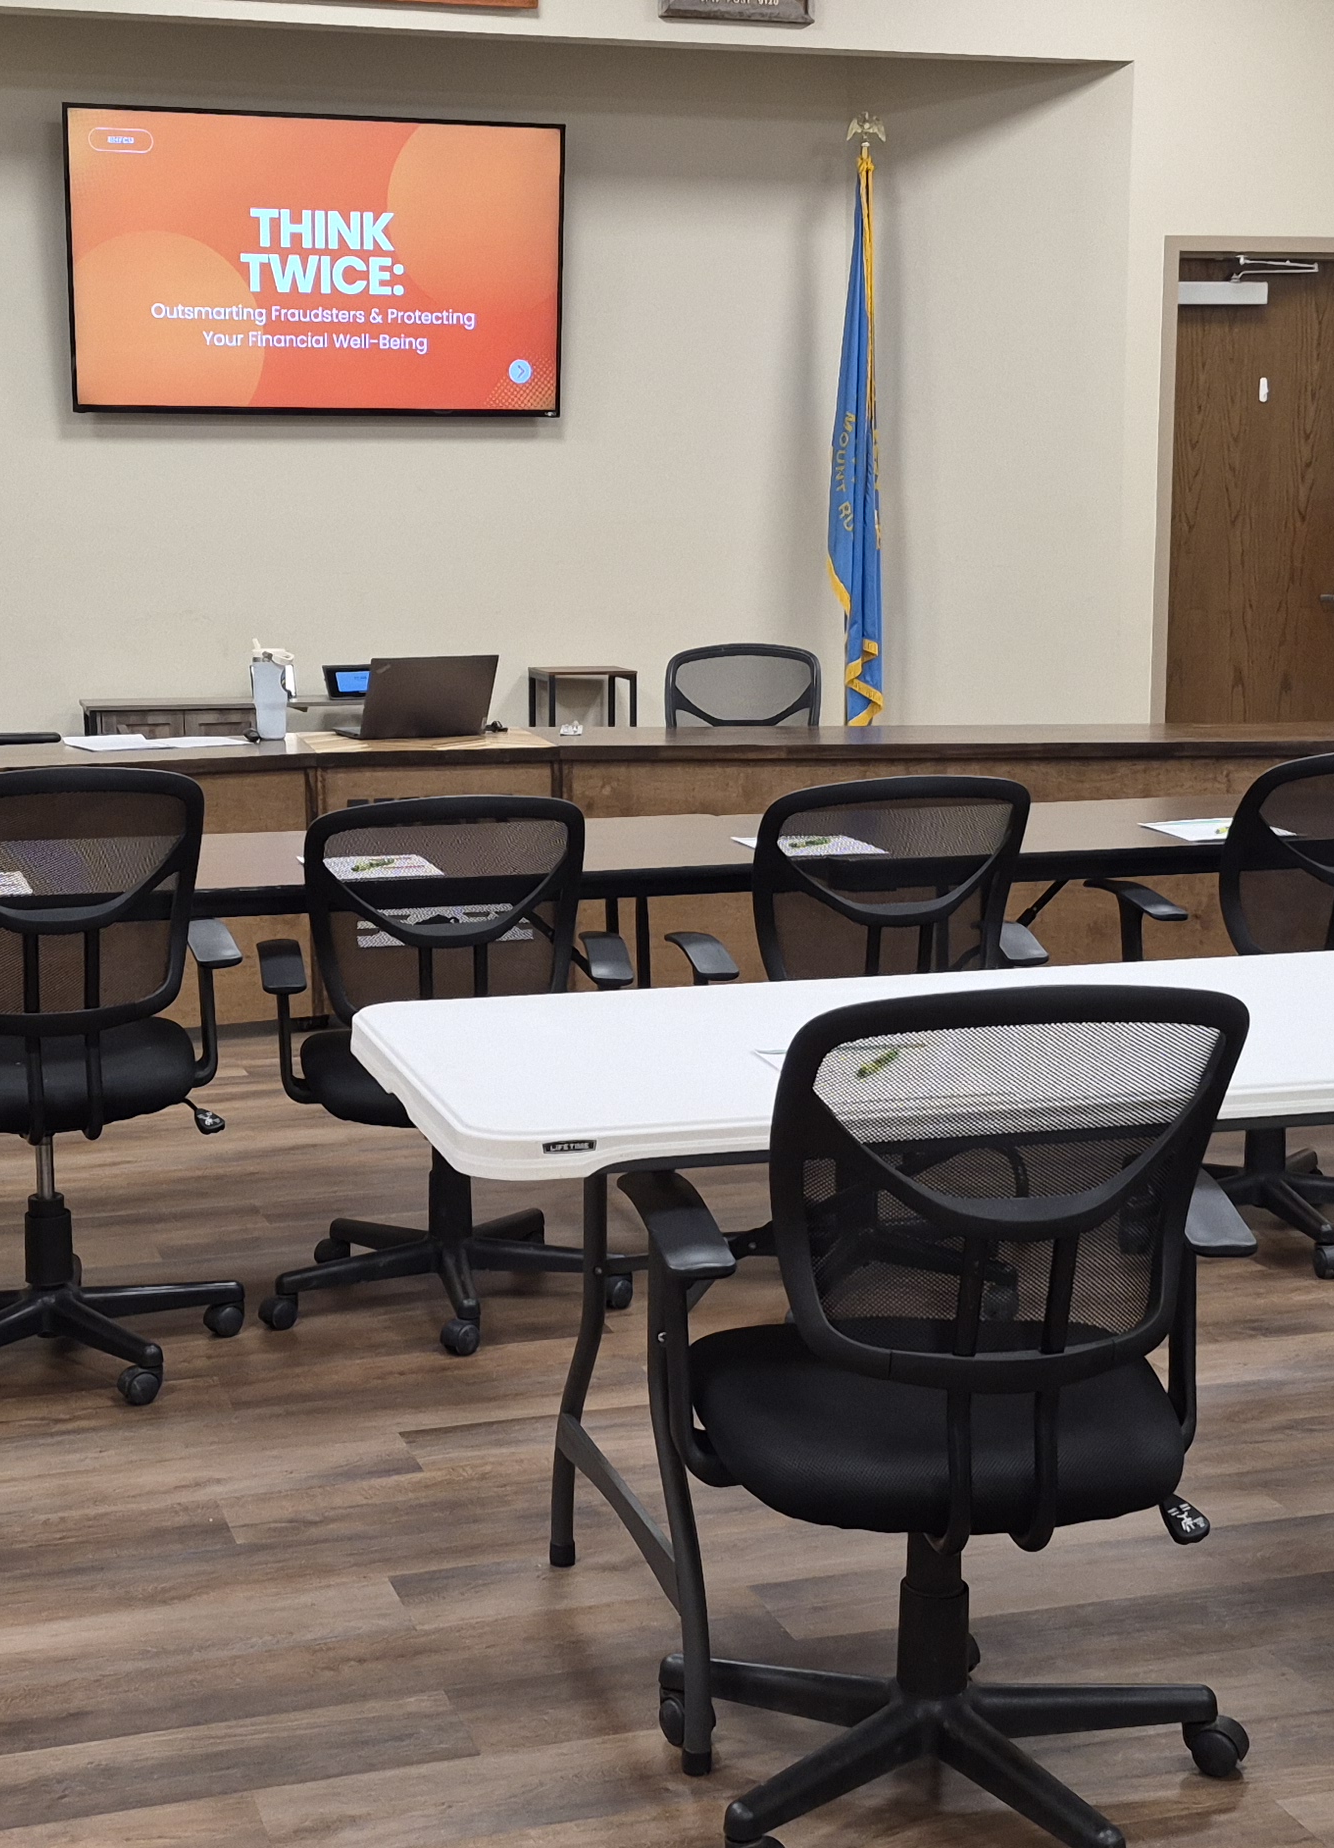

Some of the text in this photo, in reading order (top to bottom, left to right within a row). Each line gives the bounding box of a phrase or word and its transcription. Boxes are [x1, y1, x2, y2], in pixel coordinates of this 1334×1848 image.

[250, 207, 395, 251] THINK
[240, 253, 405, 296] TWICE:
[151, 302, 476, 330] Outsmarting Fraudsters & Protecting
[203, 330, 428, 354] Your Financial Well-Being
[835, 411, 857, 493] MOUNT
[550, 1142, 590, 1151] LIFETIME
